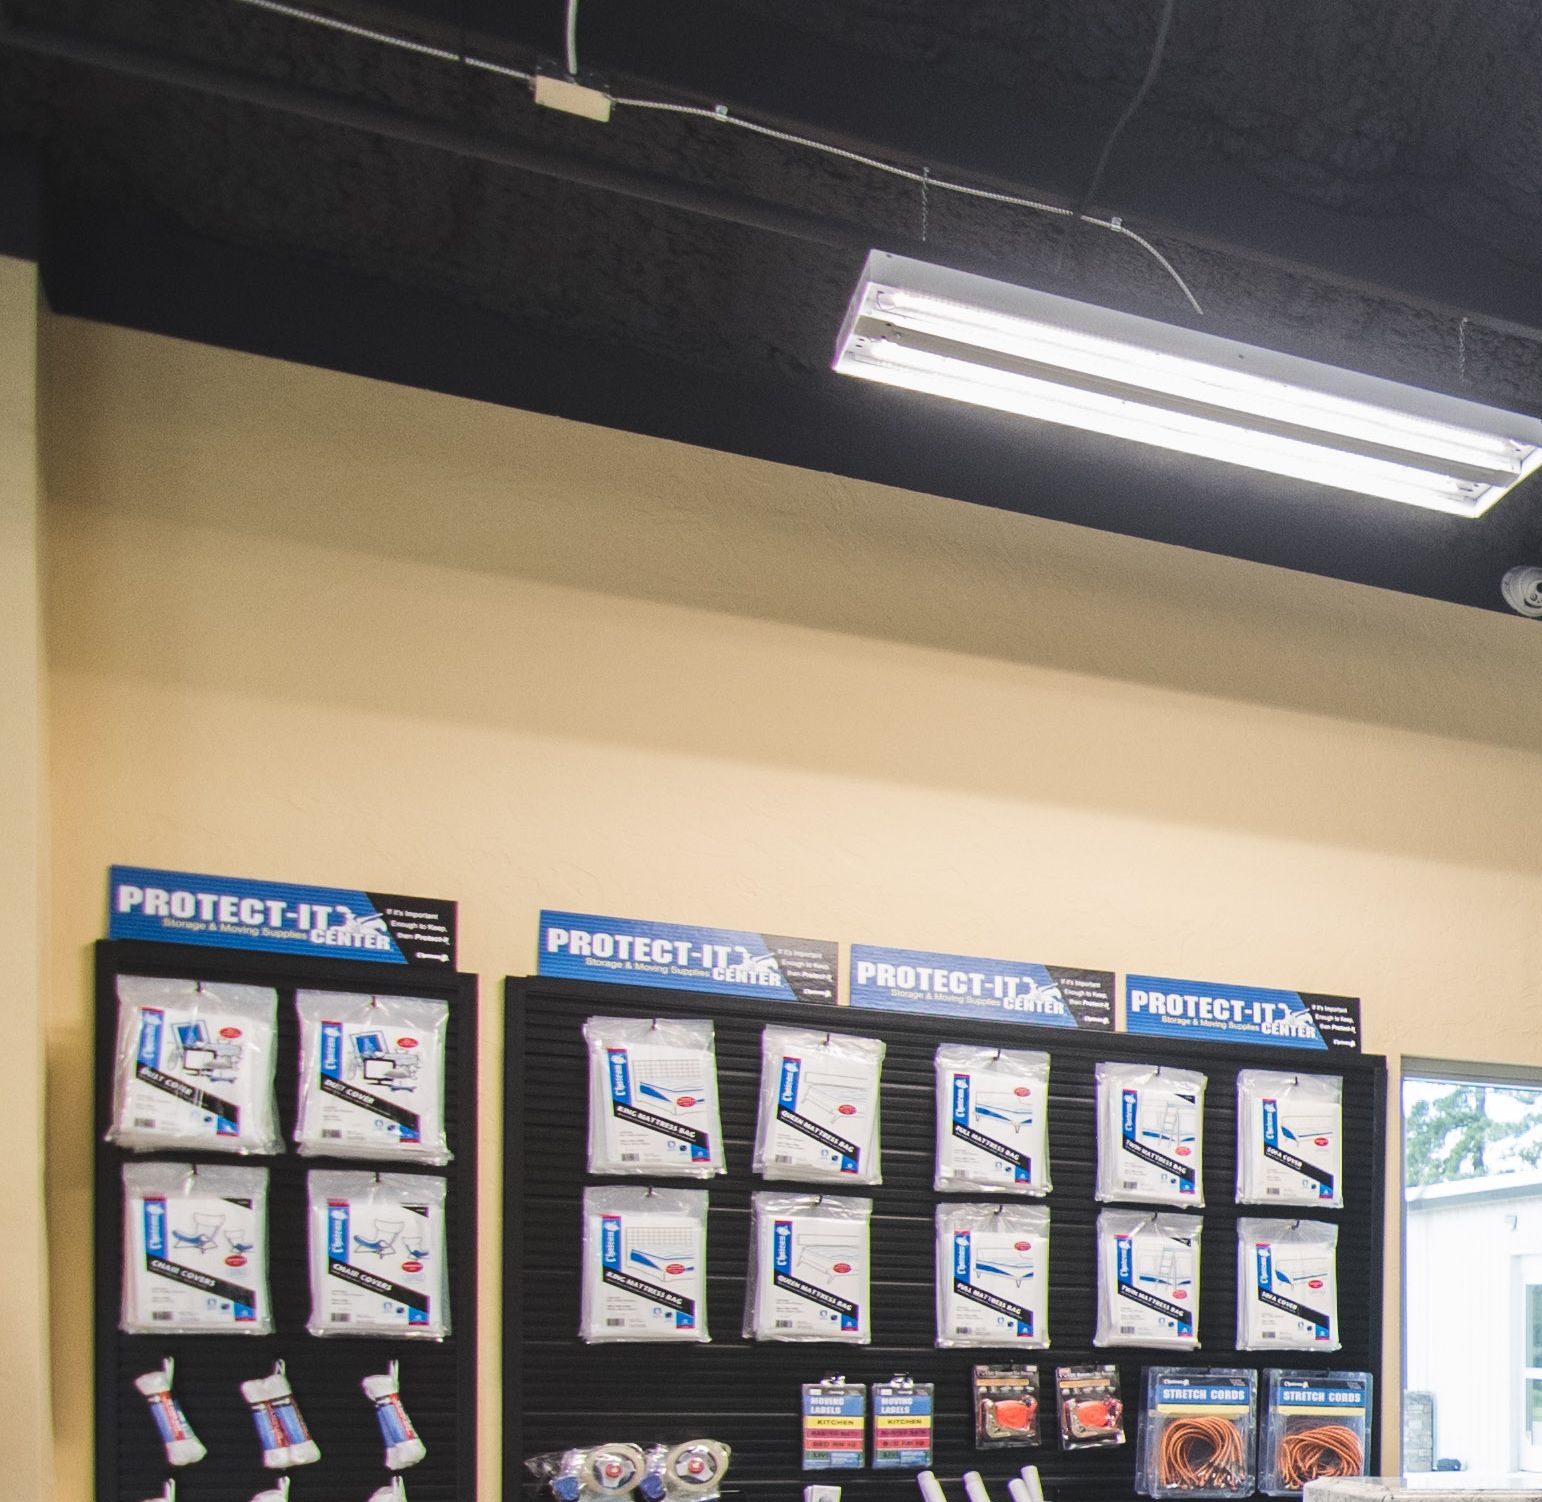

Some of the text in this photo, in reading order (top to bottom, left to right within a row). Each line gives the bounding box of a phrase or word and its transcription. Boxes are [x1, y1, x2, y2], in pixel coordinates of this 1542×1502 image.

[117, 885, 333, 930] PROTECT-IT
[162, 918, 205, 931] Storage
[220, 924, 259, 936] Moving
[262, 928, 308, 940] Supplies
[310, 929, 391, 950] CENTER
[547, 928, 731, 968] PROTECT-IT
[585, 958, 622, 969] Storage
[635, 963, 668, 974] Moving
[671, 966, 711, 977] Supplies
[712, 967, 783, 987] CENTER
[856, 961, 1020, 998] PROTECT-IT
[891, 989, 924, 999] Storage
[935, 993, 964, 1004] Moving
[1002, 997, 1065, 1015] CENTER
[1131, 990, 1277, 1023] PROTECT-IT
[1261, 1022, 1316, 1038] CENTER
[346, 1088, 375, 1104] COVER
[638, 1112, 678, 1132] MATTRESS
[805, 1119, 841, 1146] MATTRESS
[151, 1259, 216, 1287] CHAIR COVERS
[333, 1263, 392, 1291] CHAIR COVERS
[606, 1271, 683, 1305] KING MATTRESS BAG
[802, 1284, 837, 1305] MATTRESS
[973, 1289, 1006, 1308] MATTRESS
[1139, 1292, 1171, 1312] MATTRESS
[810, 1397, 845, 1406] MOVING
[880, 1397, 913, 1406] MOVING
[1163, 1389, 1245, 1400] STRETCH CORDS
[1283, 1391, 1361, 1403] STRETCH CORDS
[810, 1406, 842, 1414] LABELS
[880, 1406, 910, 1414] LABELS
